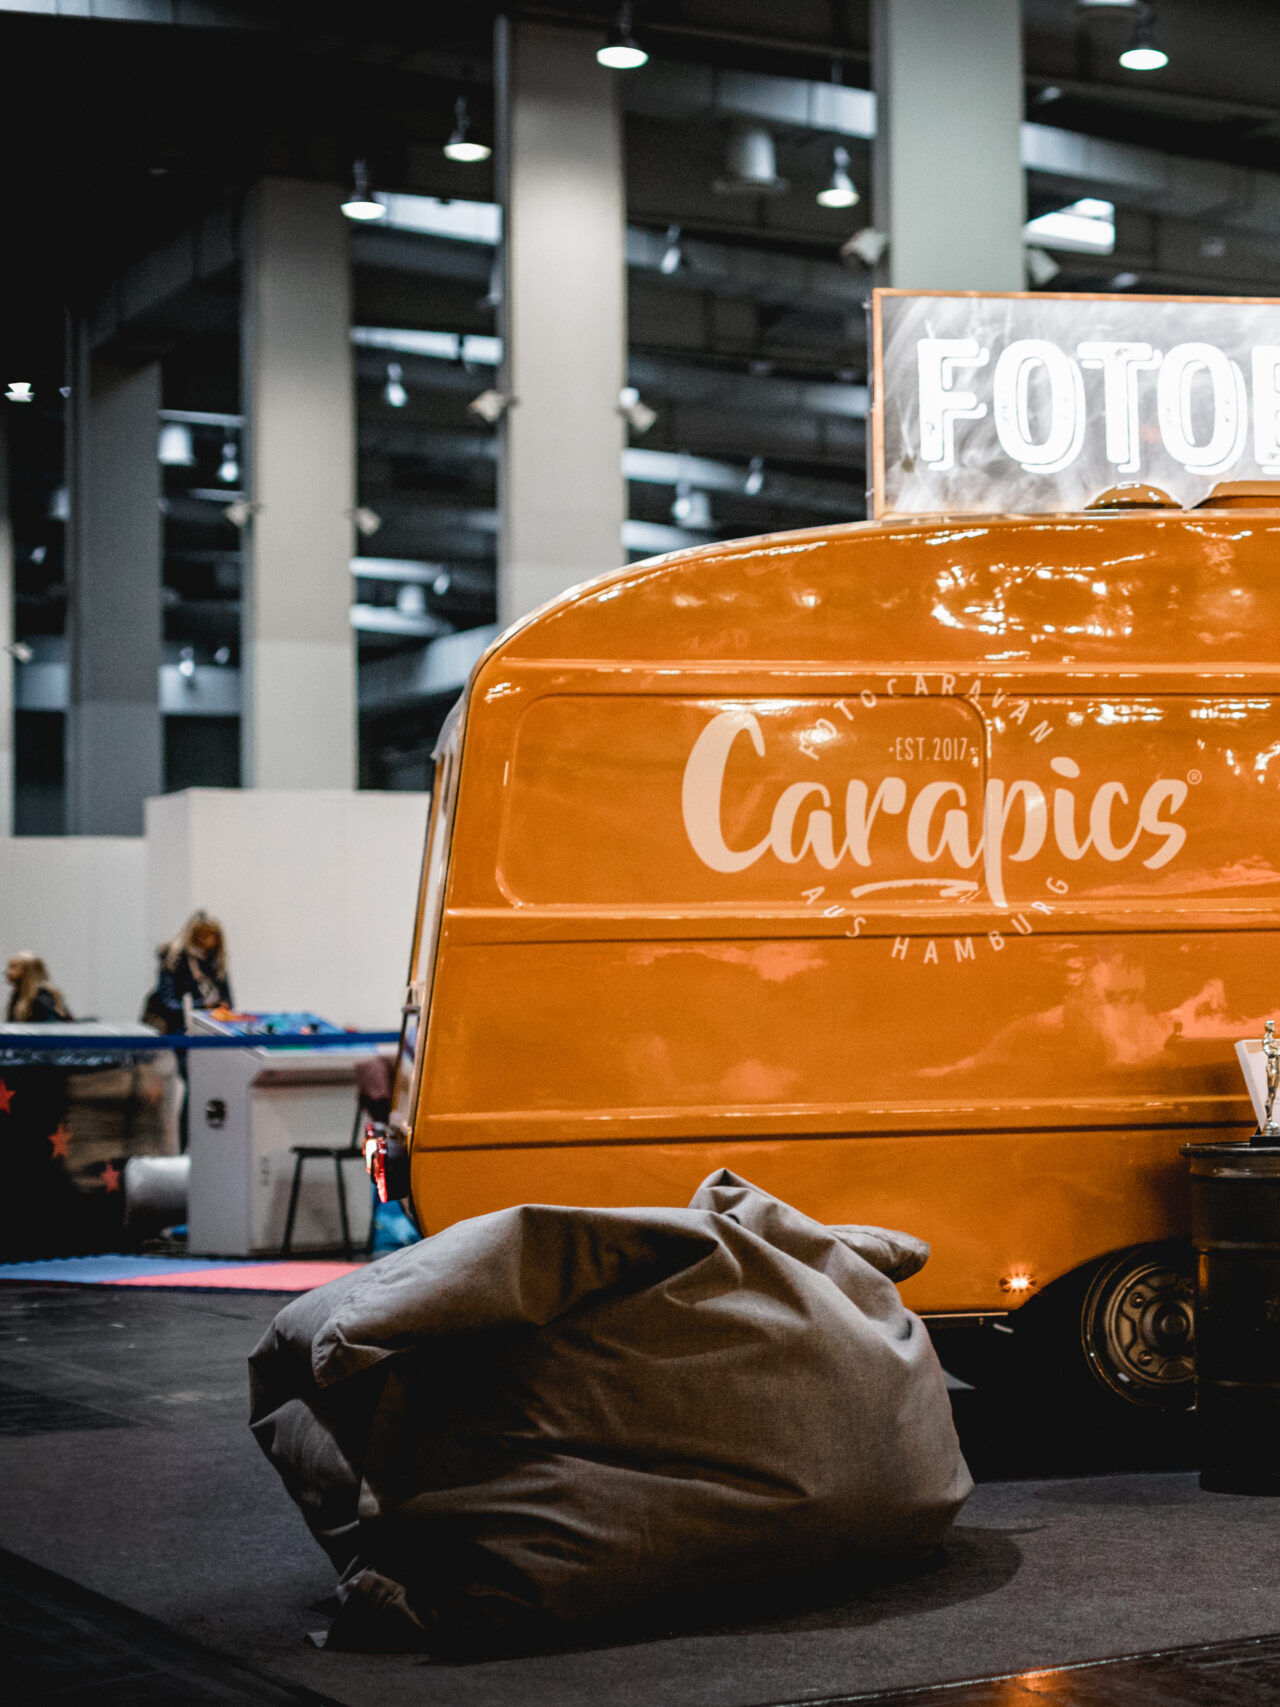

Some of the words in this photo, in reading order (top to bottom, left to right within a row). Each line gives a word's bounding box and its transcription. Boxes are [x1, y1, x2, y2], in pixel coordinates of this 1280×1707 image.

[799, 673, 1054, 760] FOTOCARAVAN
[801, 886, 867, 938] AUS
[891, 876, 1069, 965] HAMBURG
